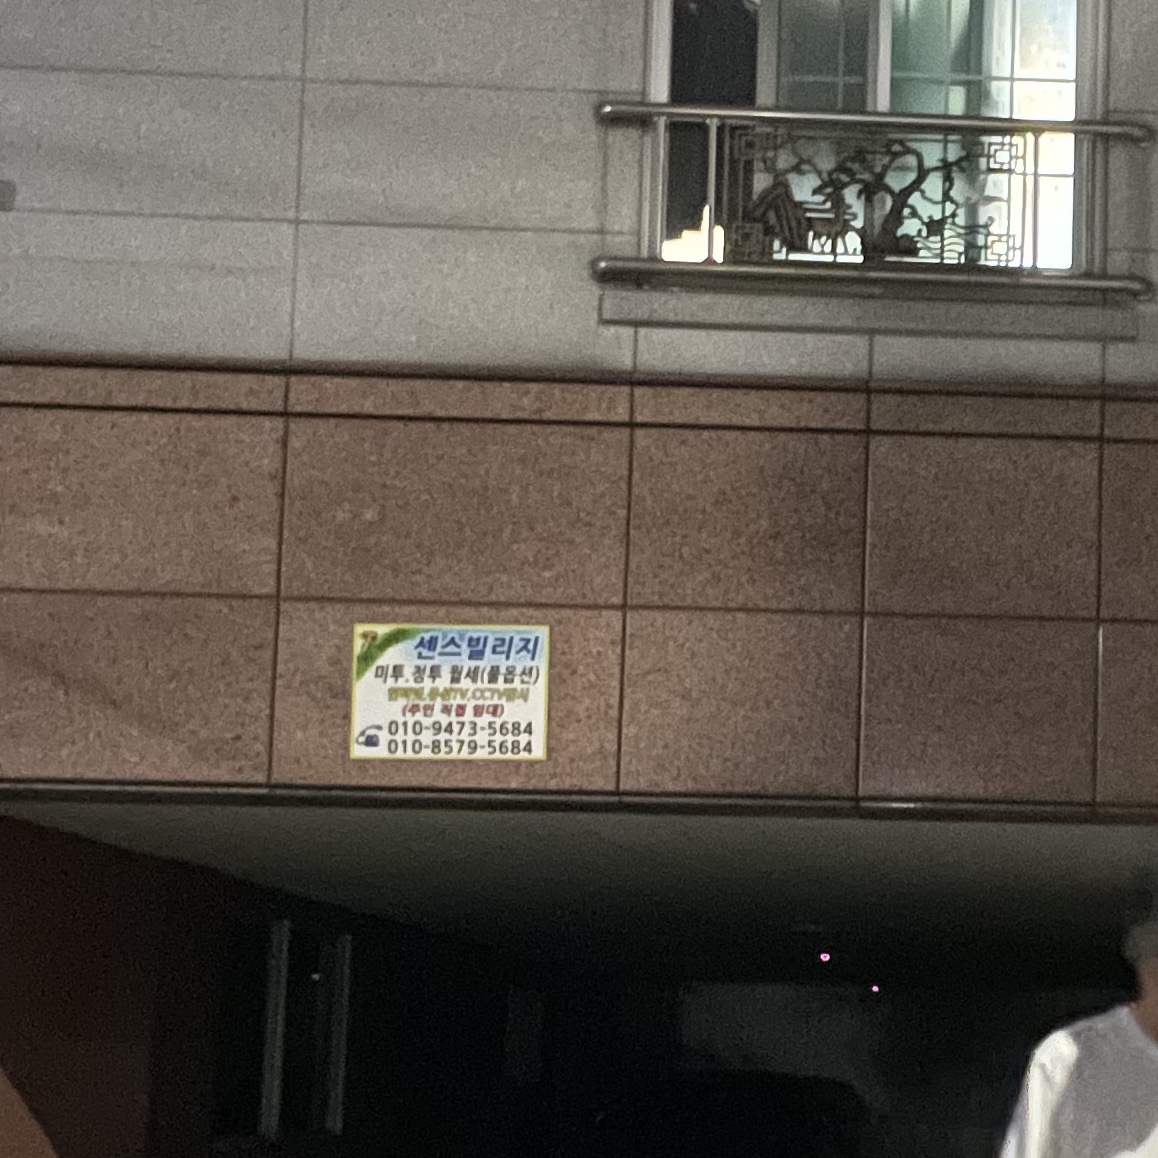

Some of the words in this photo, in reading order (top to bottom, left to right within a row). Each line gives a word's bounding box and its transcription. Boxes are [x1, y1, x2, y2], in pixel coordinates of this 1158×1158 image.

[414, 634, 540, 662] 센스빌리지
[449, 664, 540, 685] 월세(풀옵션)
[402, 703, 435, 718] (주인
[440, 703, 467, 718] 직접
[472, 703, 505, 718] 임대)
[387, 720, 533, 737] 010-9473-5684
[387, 738, 533, 755] 010-8579-5684
